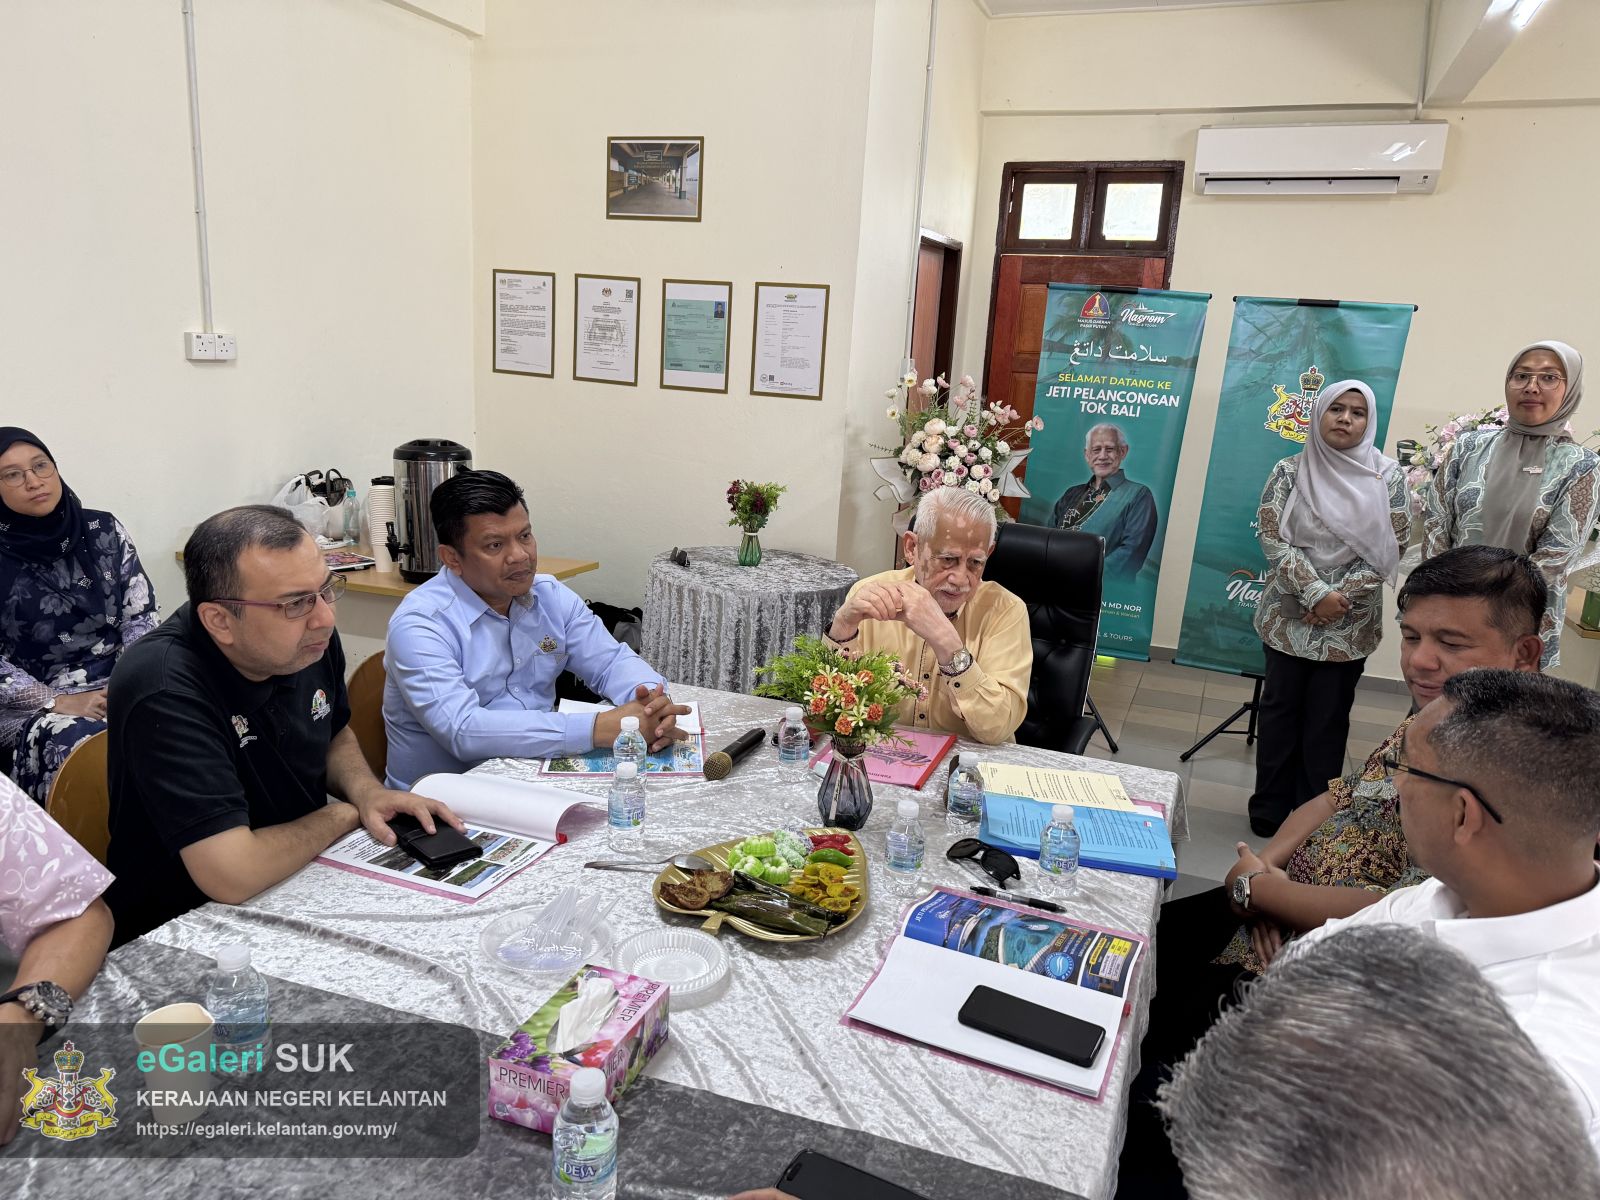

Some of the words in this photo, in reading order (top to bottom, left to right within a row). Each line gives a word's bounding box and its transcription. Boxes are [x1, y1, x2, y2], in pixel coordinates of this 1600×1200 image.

[1120, 308, 1166, 324] Nasrom
[1058, 373, 1108, 385] SELAMAT
[1109, 376, 1154, 389] DATANG
[1157, 381, 1172, 390] KE
[1046, 385, 1071, 398] JETI
[1073, 387, 1180, 408] PELANCONGAN
[1079, 400, 1106, 414] TOK
[1110, 404, 1141, 417] BALI
[1123, 604, 1142, 612] NOR
[1110, 633, 1133, 641] TOURS
[616, 982, 661, 1024] PREMIER
[499, 1066, 566, 1099] PREMIER
[563, 1162, 597, 1179] DESA
